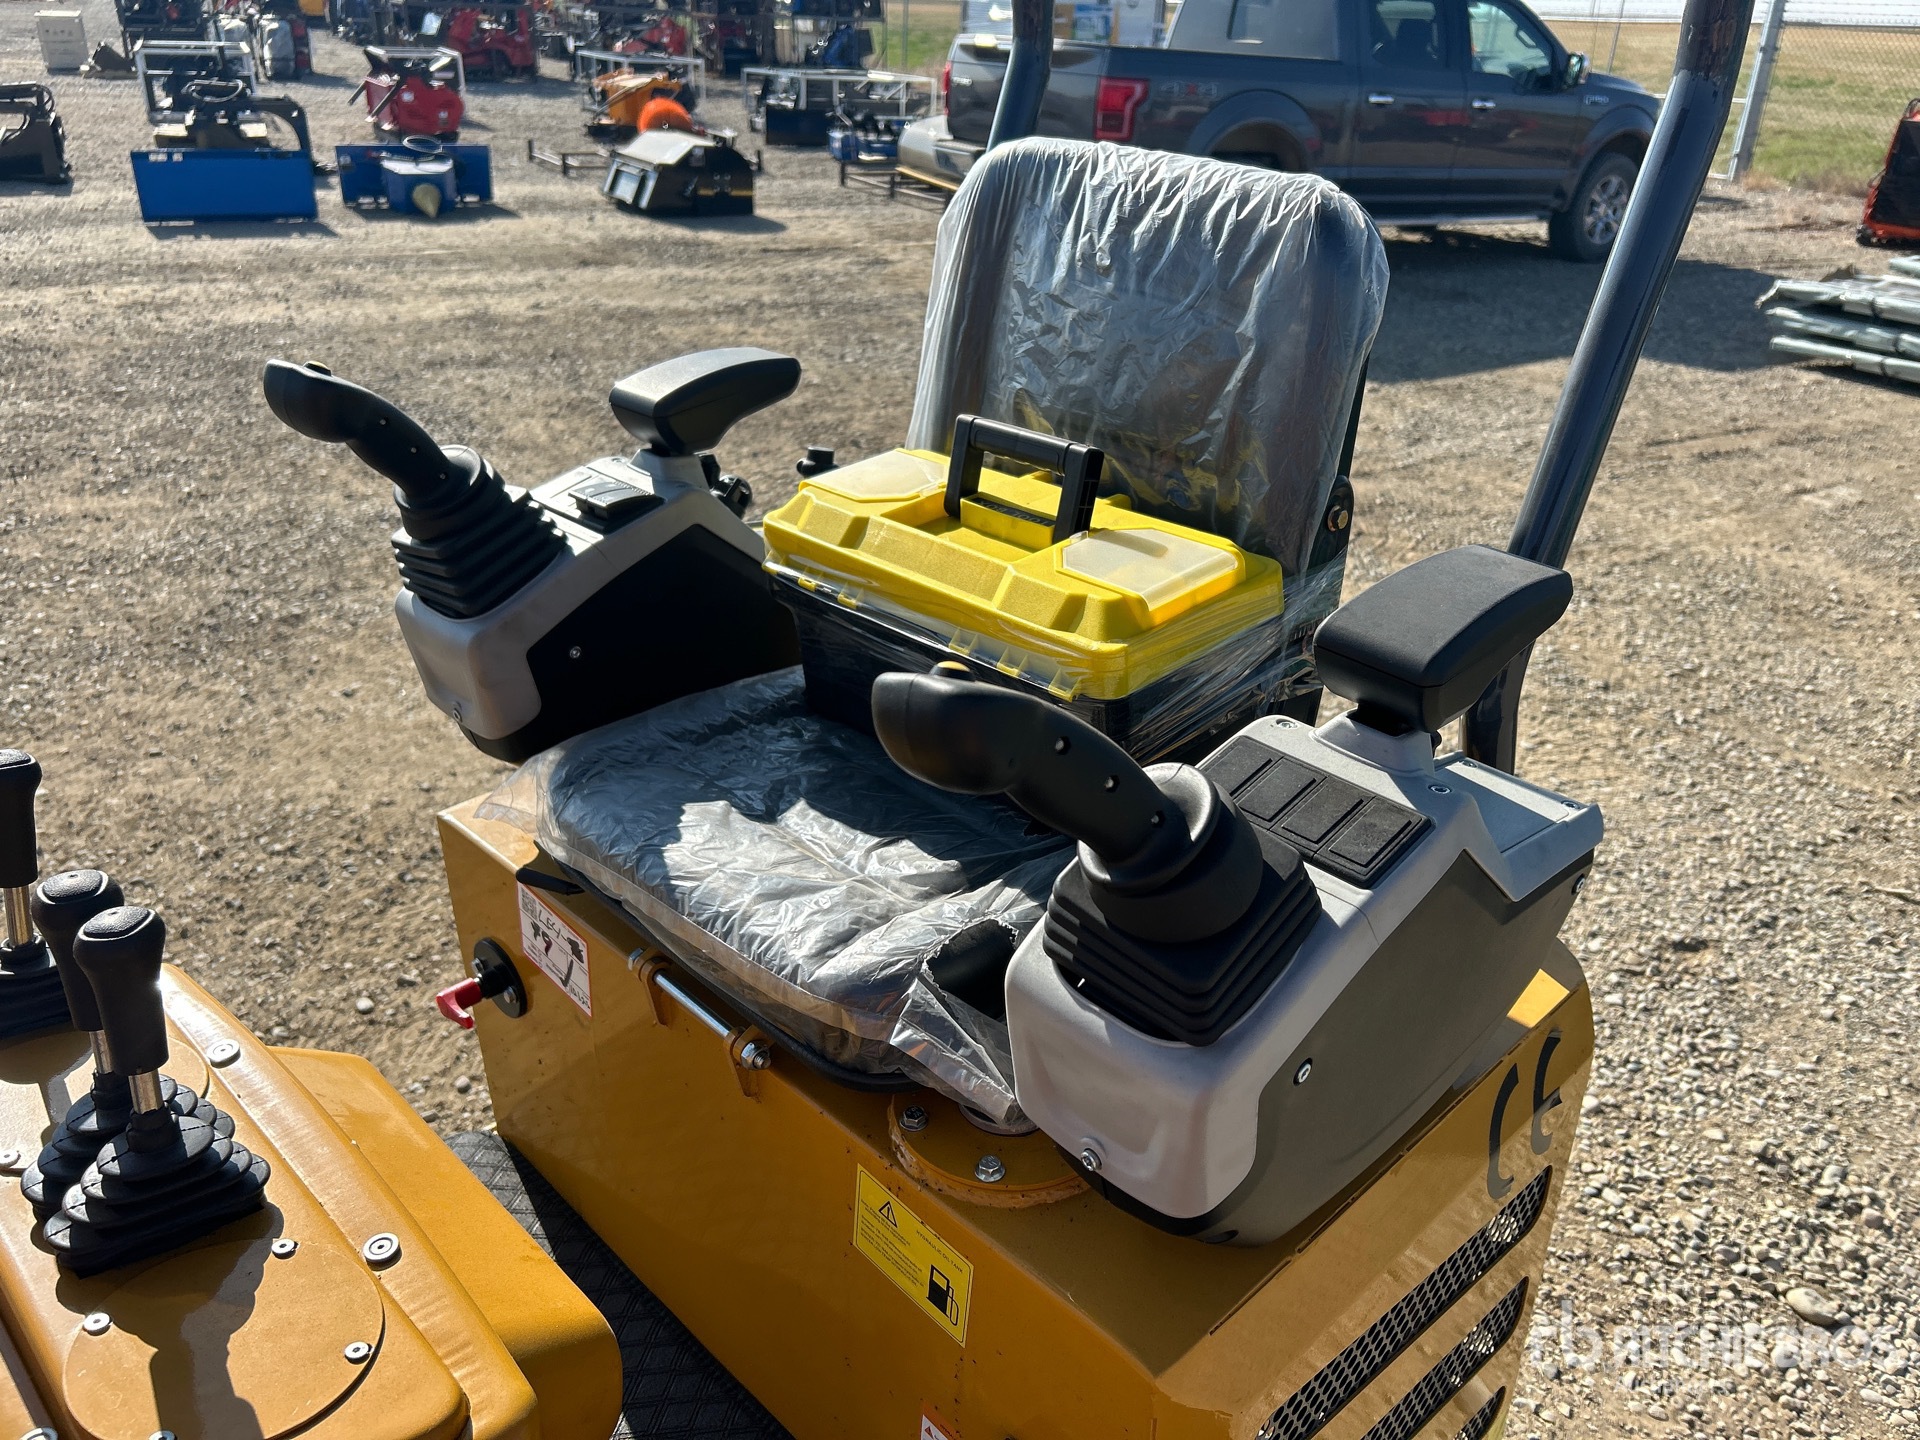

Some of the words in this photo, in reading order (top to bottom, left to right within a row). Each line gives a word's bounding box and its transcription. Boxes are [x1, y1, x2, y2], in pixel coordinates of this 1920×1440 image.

[1487, 1028, 1563, 1200] CE
[916, 1229, 943, 1255] HYDRAULIC
[950, 1259, 963, 1273] TANK
